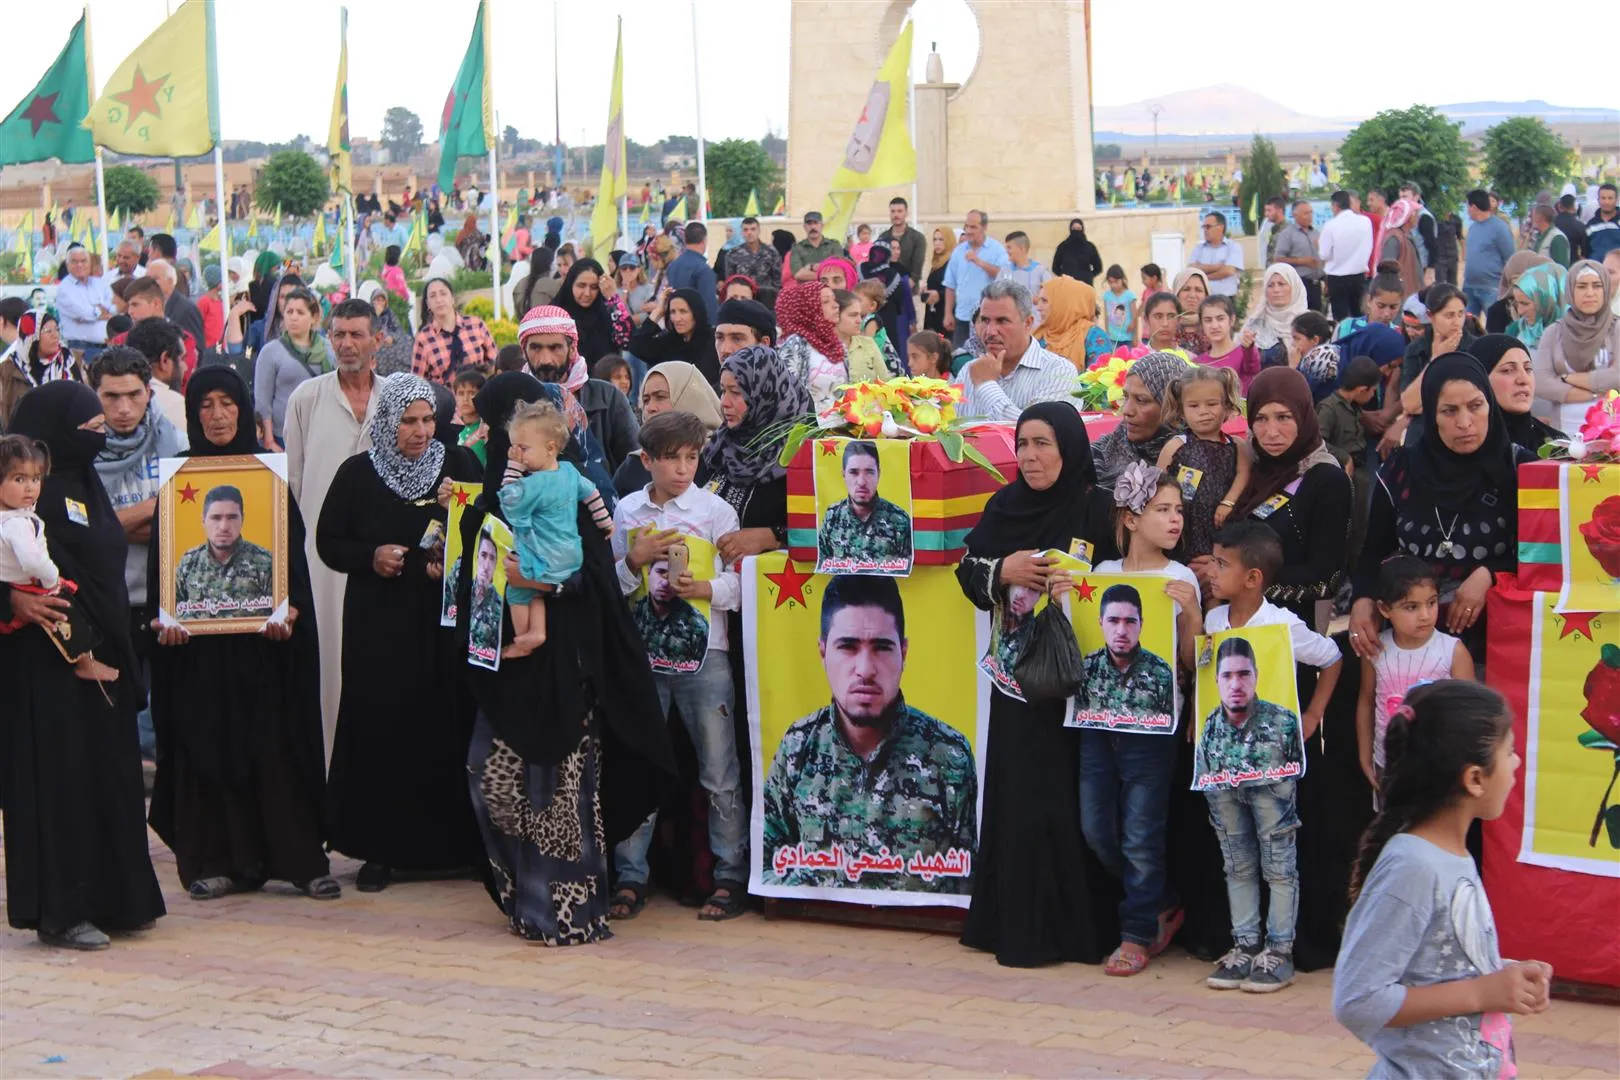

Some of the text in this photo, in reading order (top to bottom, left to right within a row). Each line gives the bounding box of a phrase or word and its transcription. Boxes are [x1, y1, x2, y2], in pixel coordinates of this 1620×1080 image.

[880, 558, 908, 571] الشهيد
[241, 596, 273, 612] الشهيد
[1139, 712, 1171, 728] الشهيد
[1266, 762, 1300, 780] الشهيد
[774, 843, 970, 881] الشهيد مضحي الحمادي
